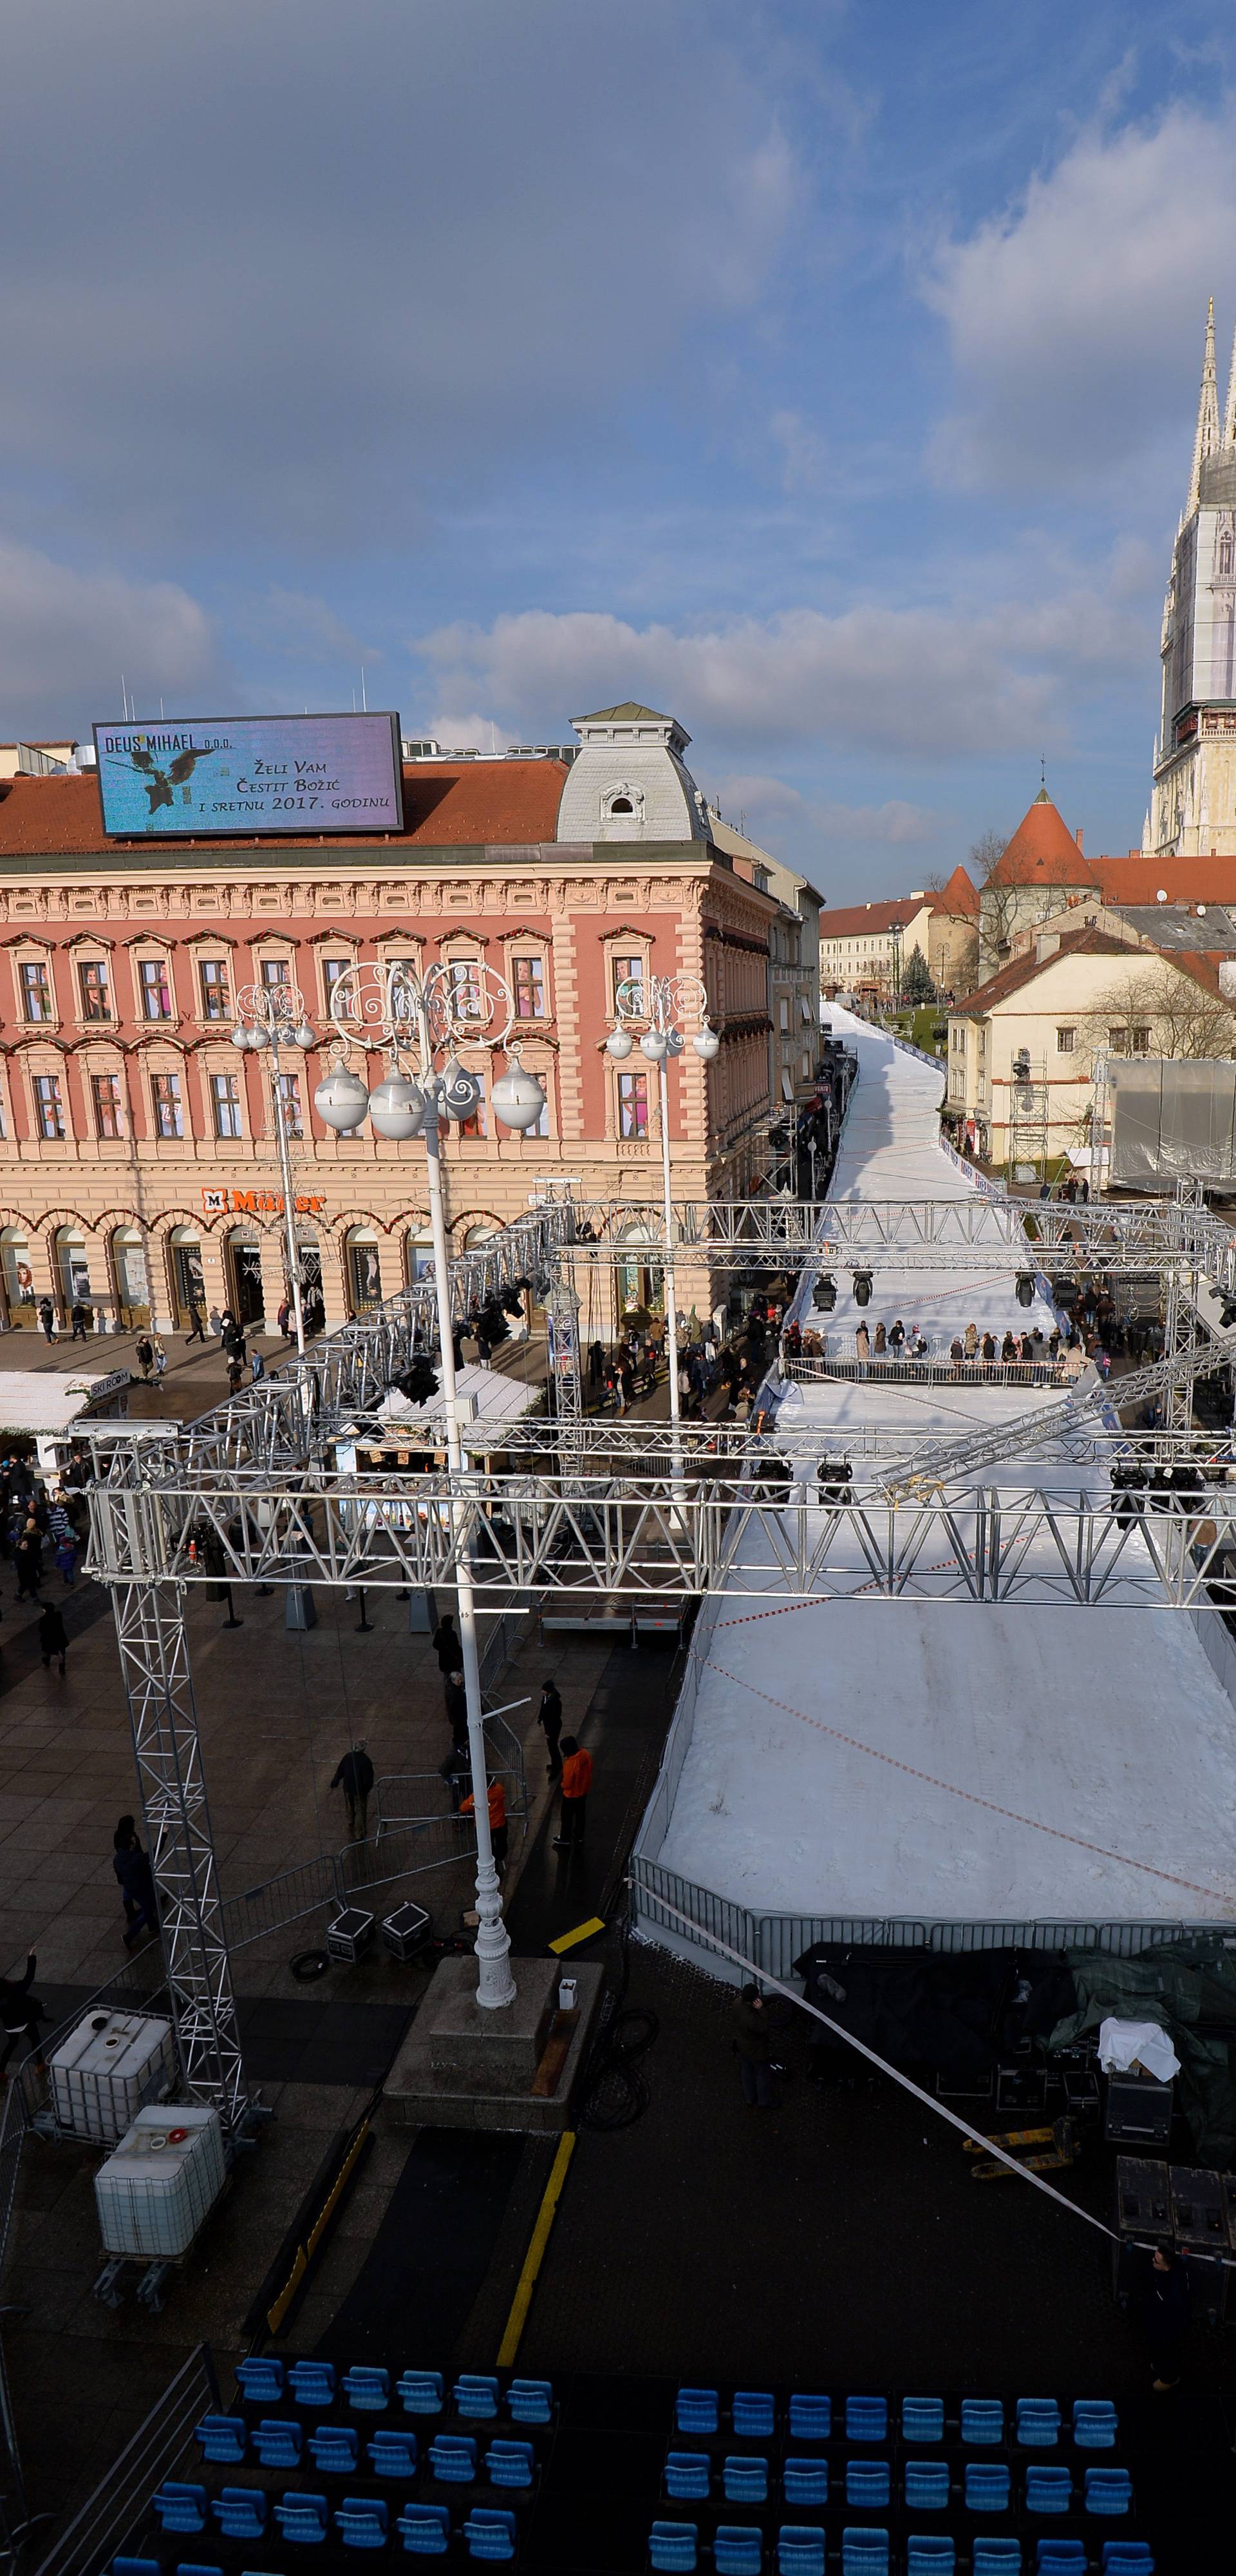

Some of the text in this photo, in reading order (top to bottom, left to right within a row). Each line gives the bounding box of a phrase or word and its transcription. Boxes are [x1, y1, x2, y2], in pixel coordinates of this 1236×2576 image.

[105, 736, 142, 752] DEUS
[146, 734, 196, 751] MIHAEL
[272, 797, 324, 810] 2017.
[207, 1191, 327, 1211] M Müler
[93, 1372, 128, 1396] SKI ROOM
